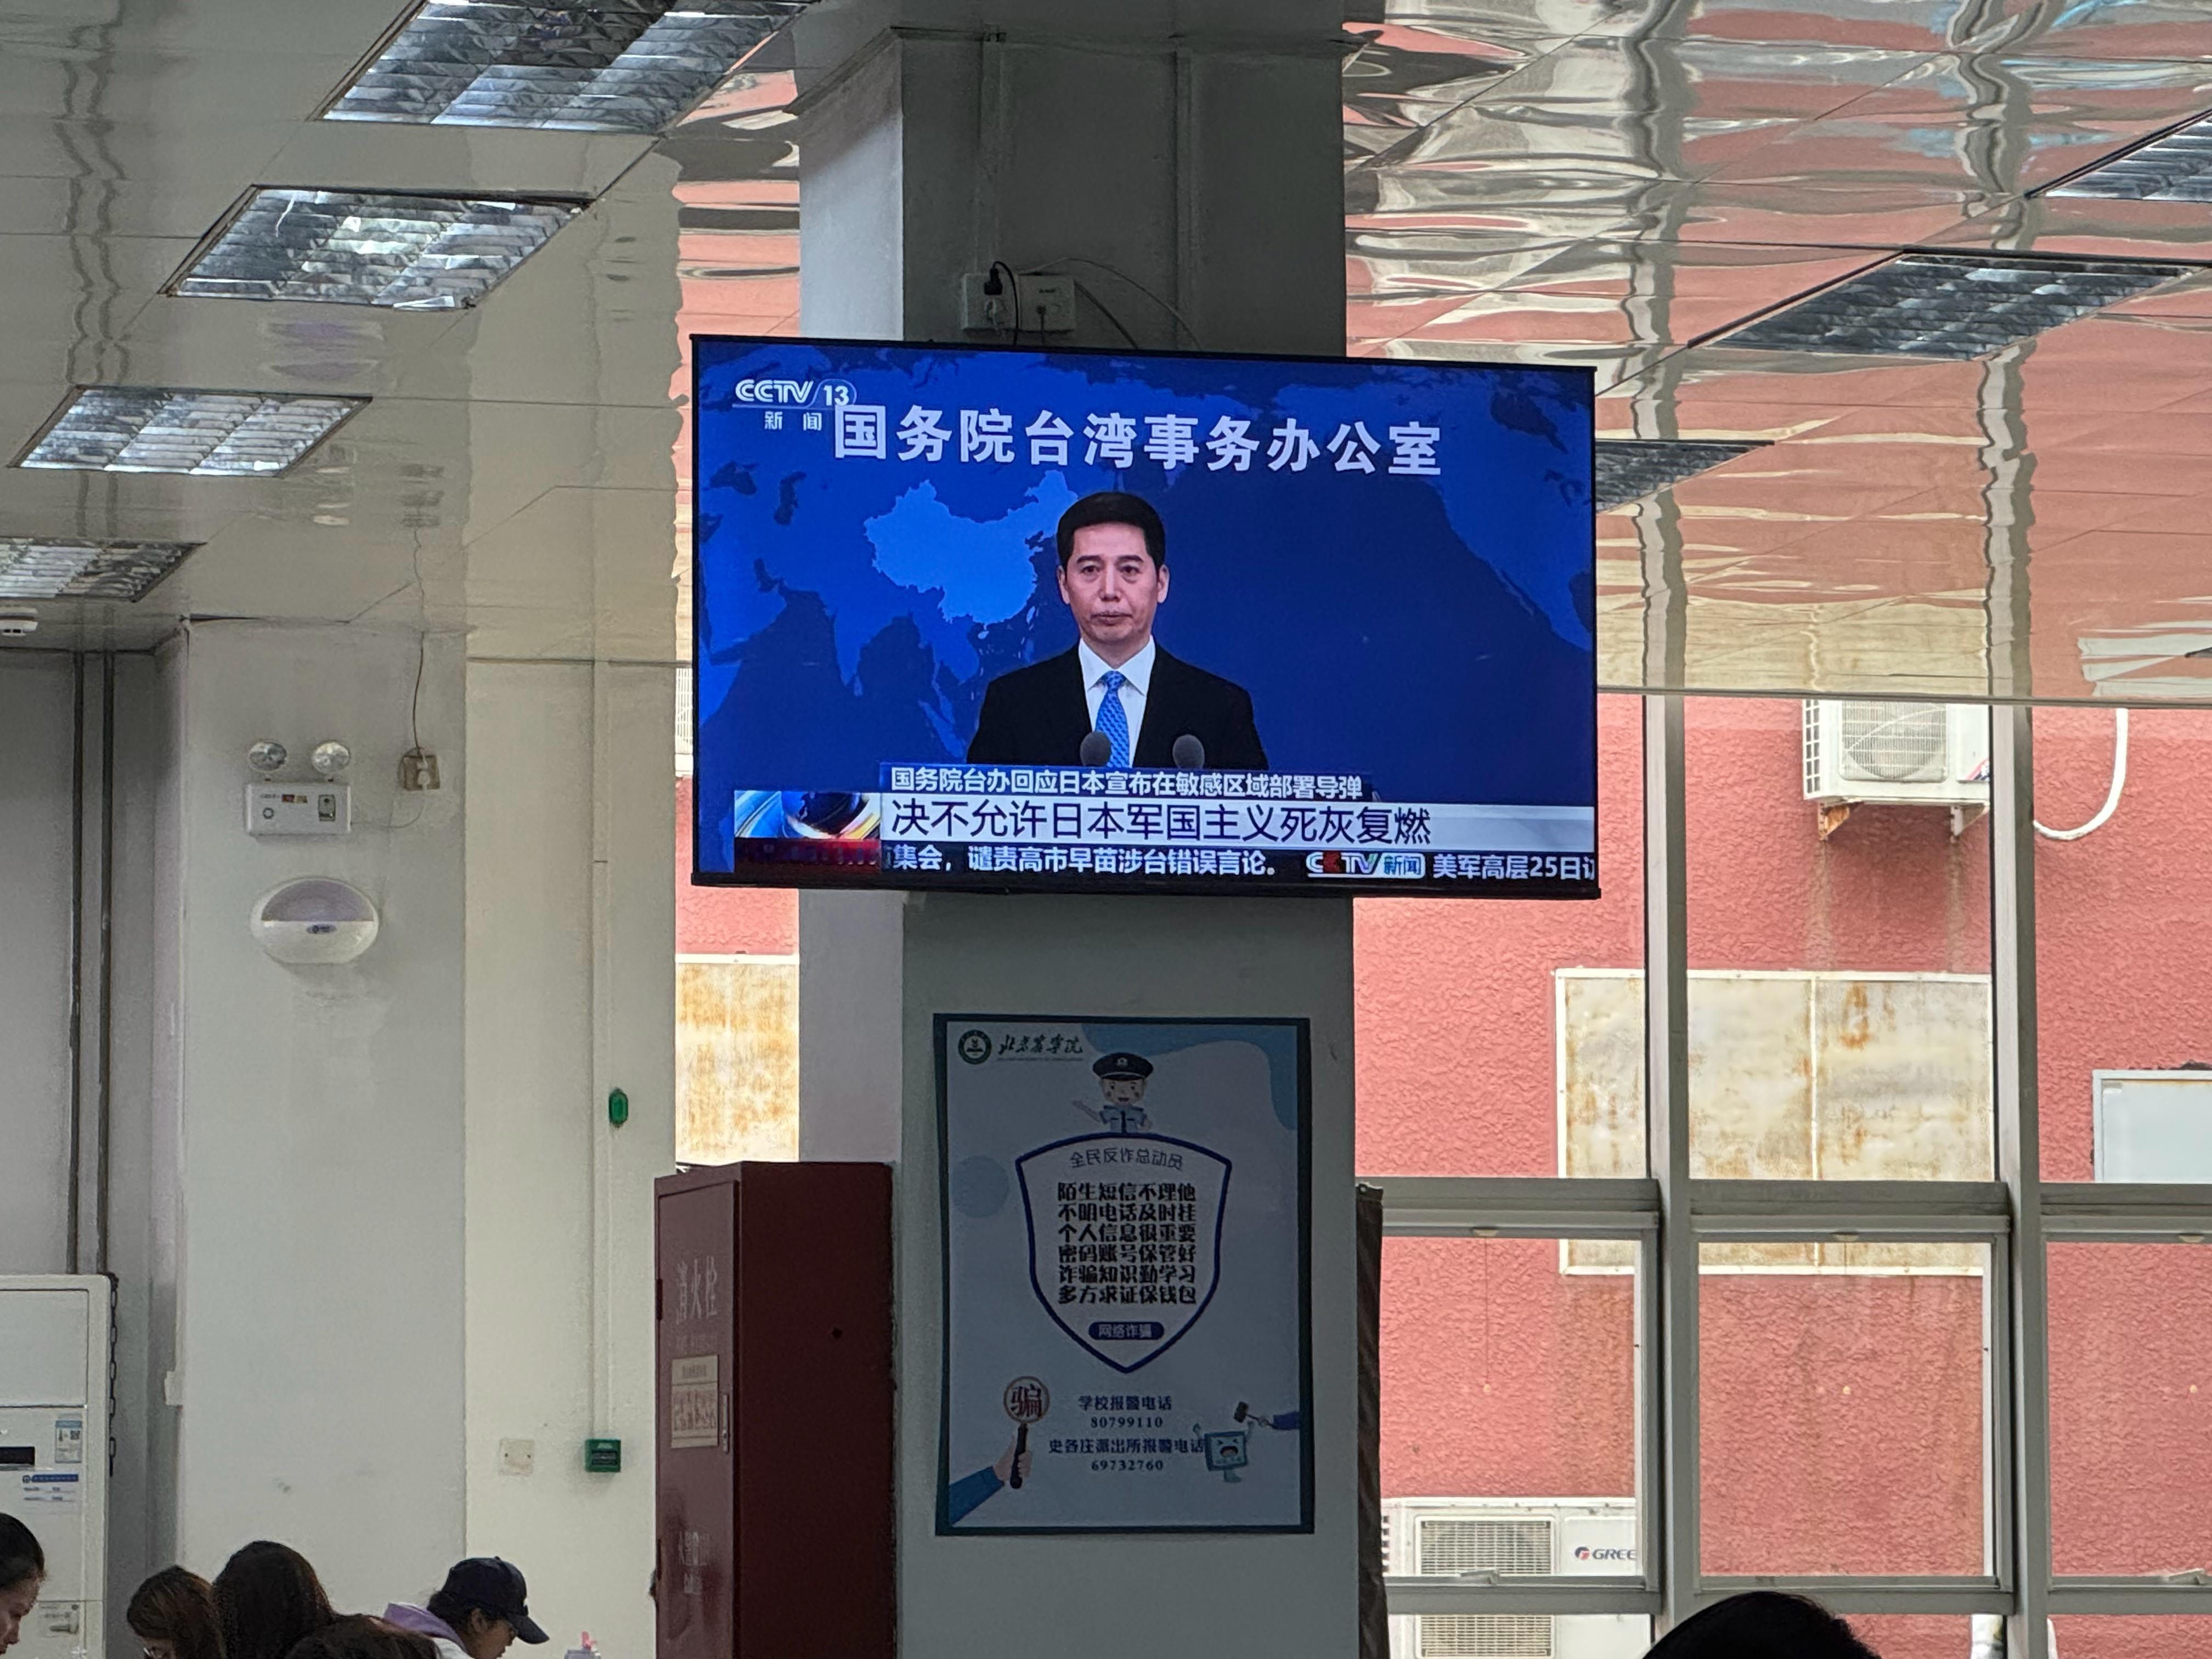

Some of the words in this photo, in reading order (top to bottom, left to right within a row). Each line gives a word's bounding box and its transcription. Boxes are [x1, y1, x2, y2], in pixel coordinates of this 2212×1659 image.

[735, 379, 814, 403] CCTV
[823, 385, 850, 406] 13
[765, 411, 822, 431] 新闻
[834, 403, 1442, 477] 国务院台湾事务办公室
[891, 767, 1363, 800] 国务院台办回应日本宣布在敏感区域部署导弹
[891, 798, 1431, 844] 决不允许日本军国主义死灰复燃
[1070, 1147, 1183, 1170] 全民反诈总动员
[1058, 1182, 1196, 1201] 陌生短信不理他
[1058, 1204, 1196, 1222] 不明电话及时挂
[1058, 1223, 1196, 1243] 个人信息很重要
[1058, 1244, 1196, 1263] 密码账号保管好
[1058, 1265, 1196, 1283] 诈骗知识勤学习
[1058, 1285, 1196, 1304] 多方求证保钱包
[1011, 1384, 1042, 1419] 骗
[1077, 1396, 1172, 1412] 学校报警电话
[1091, 1417, 1164, 1428] 80799110
[1048, 1438, 1205, 1454] 史各庄派出所报警电话
[1091, 1460, 1164, 1471] 69732760
[1592, 1548, 1637, 1560] GREE
